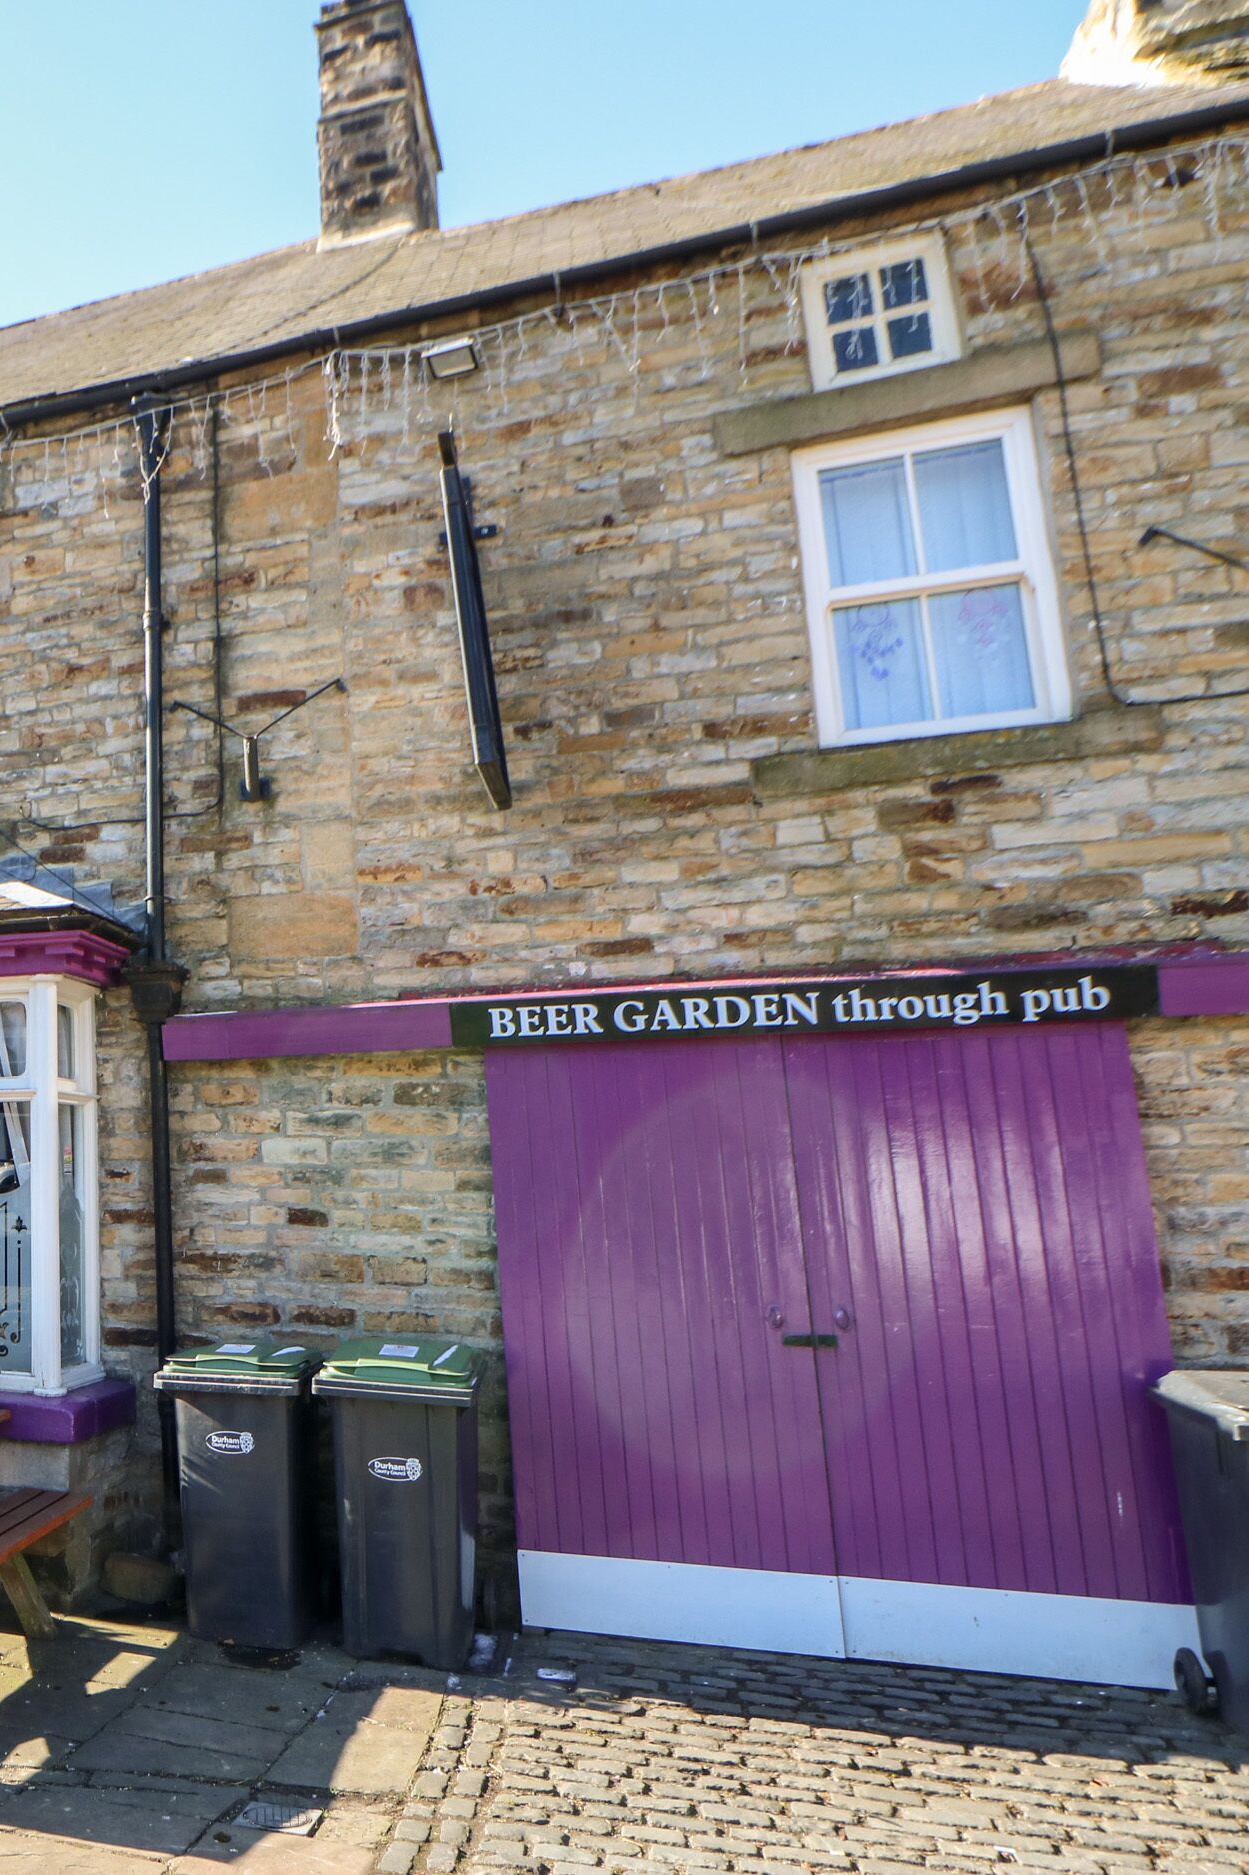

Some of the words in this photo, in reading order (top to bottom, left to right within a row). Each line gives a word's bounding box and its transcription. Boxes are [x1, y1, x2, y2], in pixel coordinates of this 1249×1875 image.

[488, 1003, 604, 1038] BEER
[613, 991, 821, 1032] GARDEN
[831, 981, 1010, 1025] through
[1020, 975, 1111, 1023] pub
[212, 1435, 240, 1444] Durham
[374, 1460, 406, 1471] Durham
